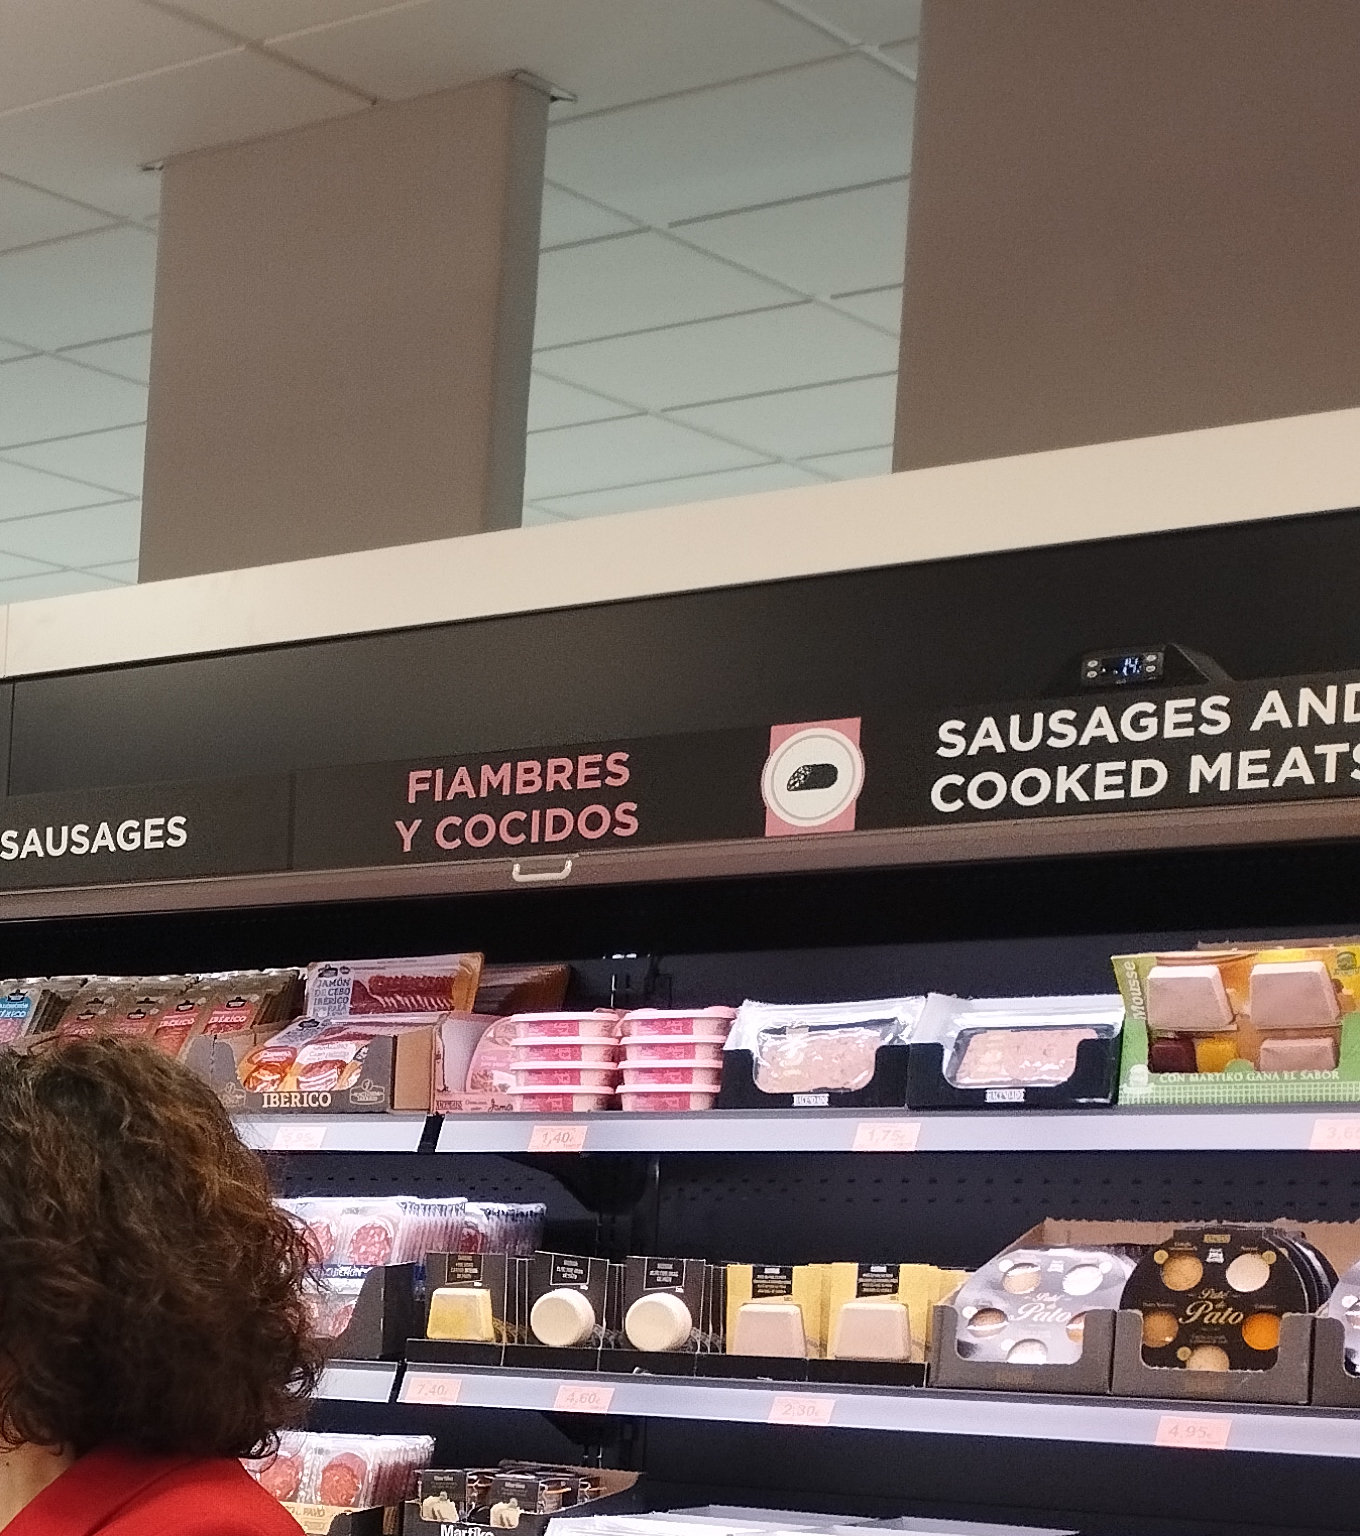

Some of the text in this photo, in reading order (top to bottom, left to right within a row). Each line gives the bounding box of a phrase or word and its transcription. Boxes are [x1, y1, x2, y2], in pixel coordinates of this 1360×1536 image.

[935, 695, 1232, 759] SAUSAGES
[407, 751, 632, 805] FIAMBRES
[930, 743, 1360, 813] COOKED MEAT
[0, 815, 189, 862] SAUSAGES
[395, 802, 640, 854] Y COCIDOS
[317, 977, 351, 987] JAMÓN
[1124, 961, 1147, 1020] Mousse
[1159, 1069, 1340, 1083] CON MARTIKO GANA EL SABOR
[1179, 1300, 1244, 1325] Pato
